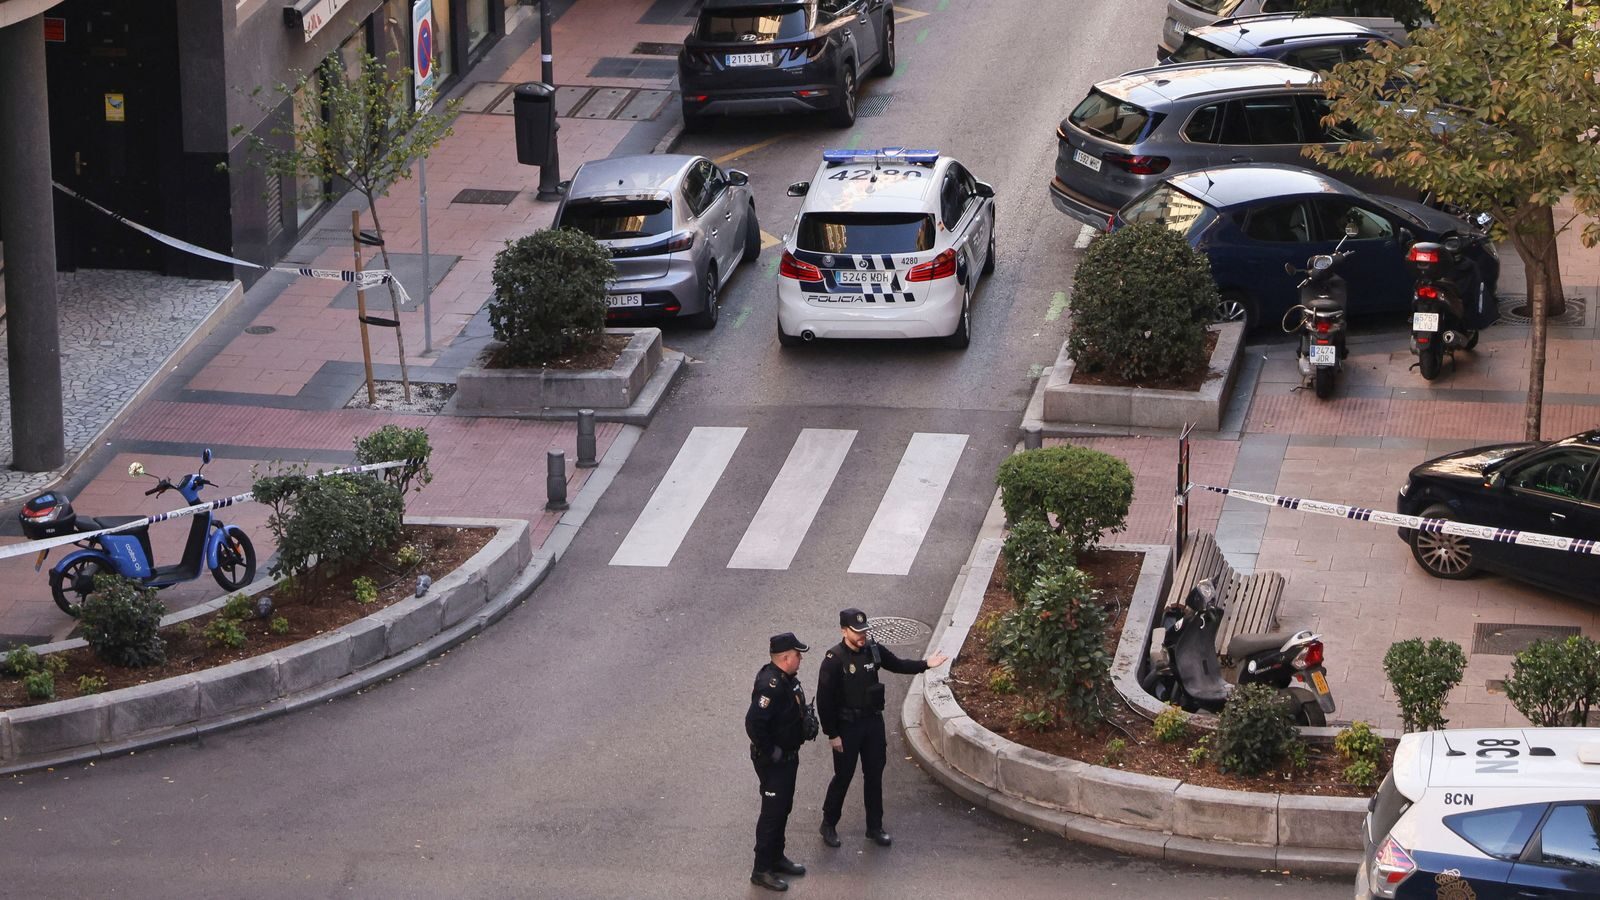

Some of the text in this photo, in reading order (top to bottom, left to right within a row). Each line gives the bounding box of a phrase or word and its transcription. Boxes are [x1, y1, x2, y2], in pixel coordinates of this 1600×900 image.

[731, 54, 770, 64] 2113 LXT
[901, 257, 918, 265] 4280
[842, 272, 889, 282] 5246 MDH
[620, 295, 639, 306] LPS
[807, 295, 864, 303] POLICIA
[1316, 346, 1334, 355] 2474
[1475, 739, 1520, 773] 8CN
[1444, 792, 1474, 806] 8CN
